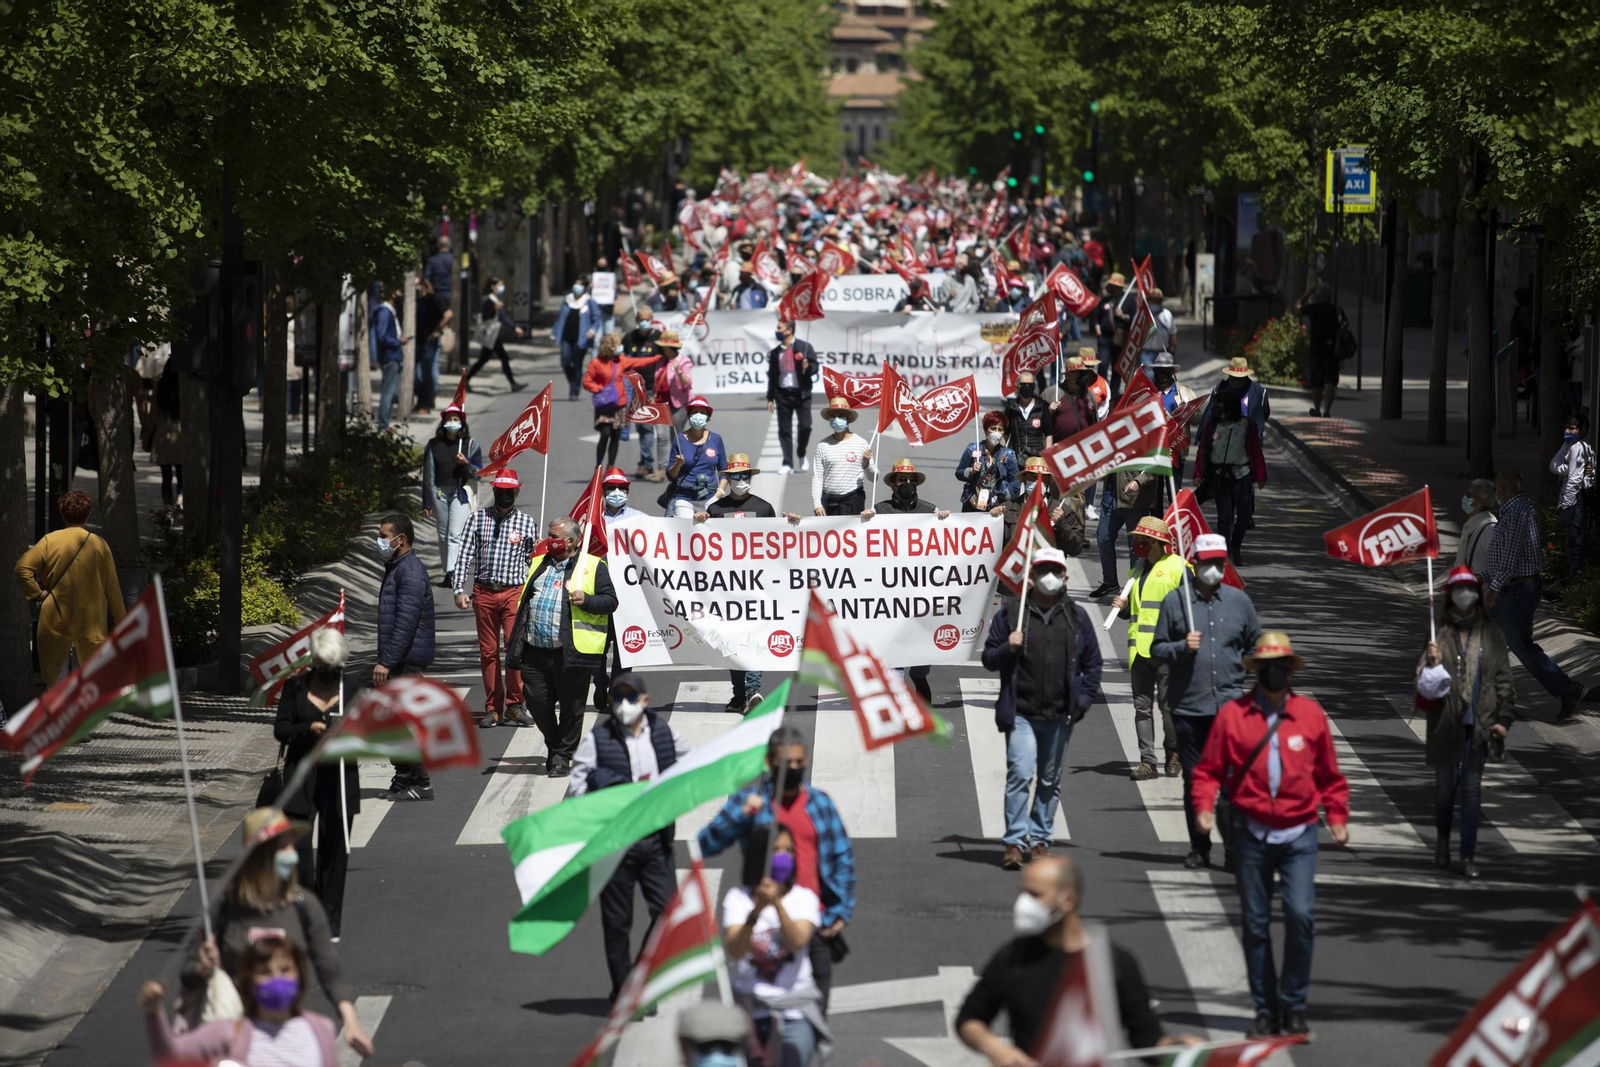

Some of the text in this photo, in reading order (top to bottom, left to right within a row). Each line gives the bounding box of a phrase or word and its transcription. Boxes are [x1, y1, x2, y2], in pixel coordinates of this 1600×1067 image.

[1345, 179, 1365, 190] AXI
[843, 287, 896, 301] SOBRA
[614, 526, 995, 561] NO A LOS DESPIDOS EN BANCA
[624, 564, 765, 592] CAIXABANK
[789, 567, 856, 590] BBVA
[881, 563, 990, 589] UNICAJA
[662, 597, 784, 621] SABADELL
